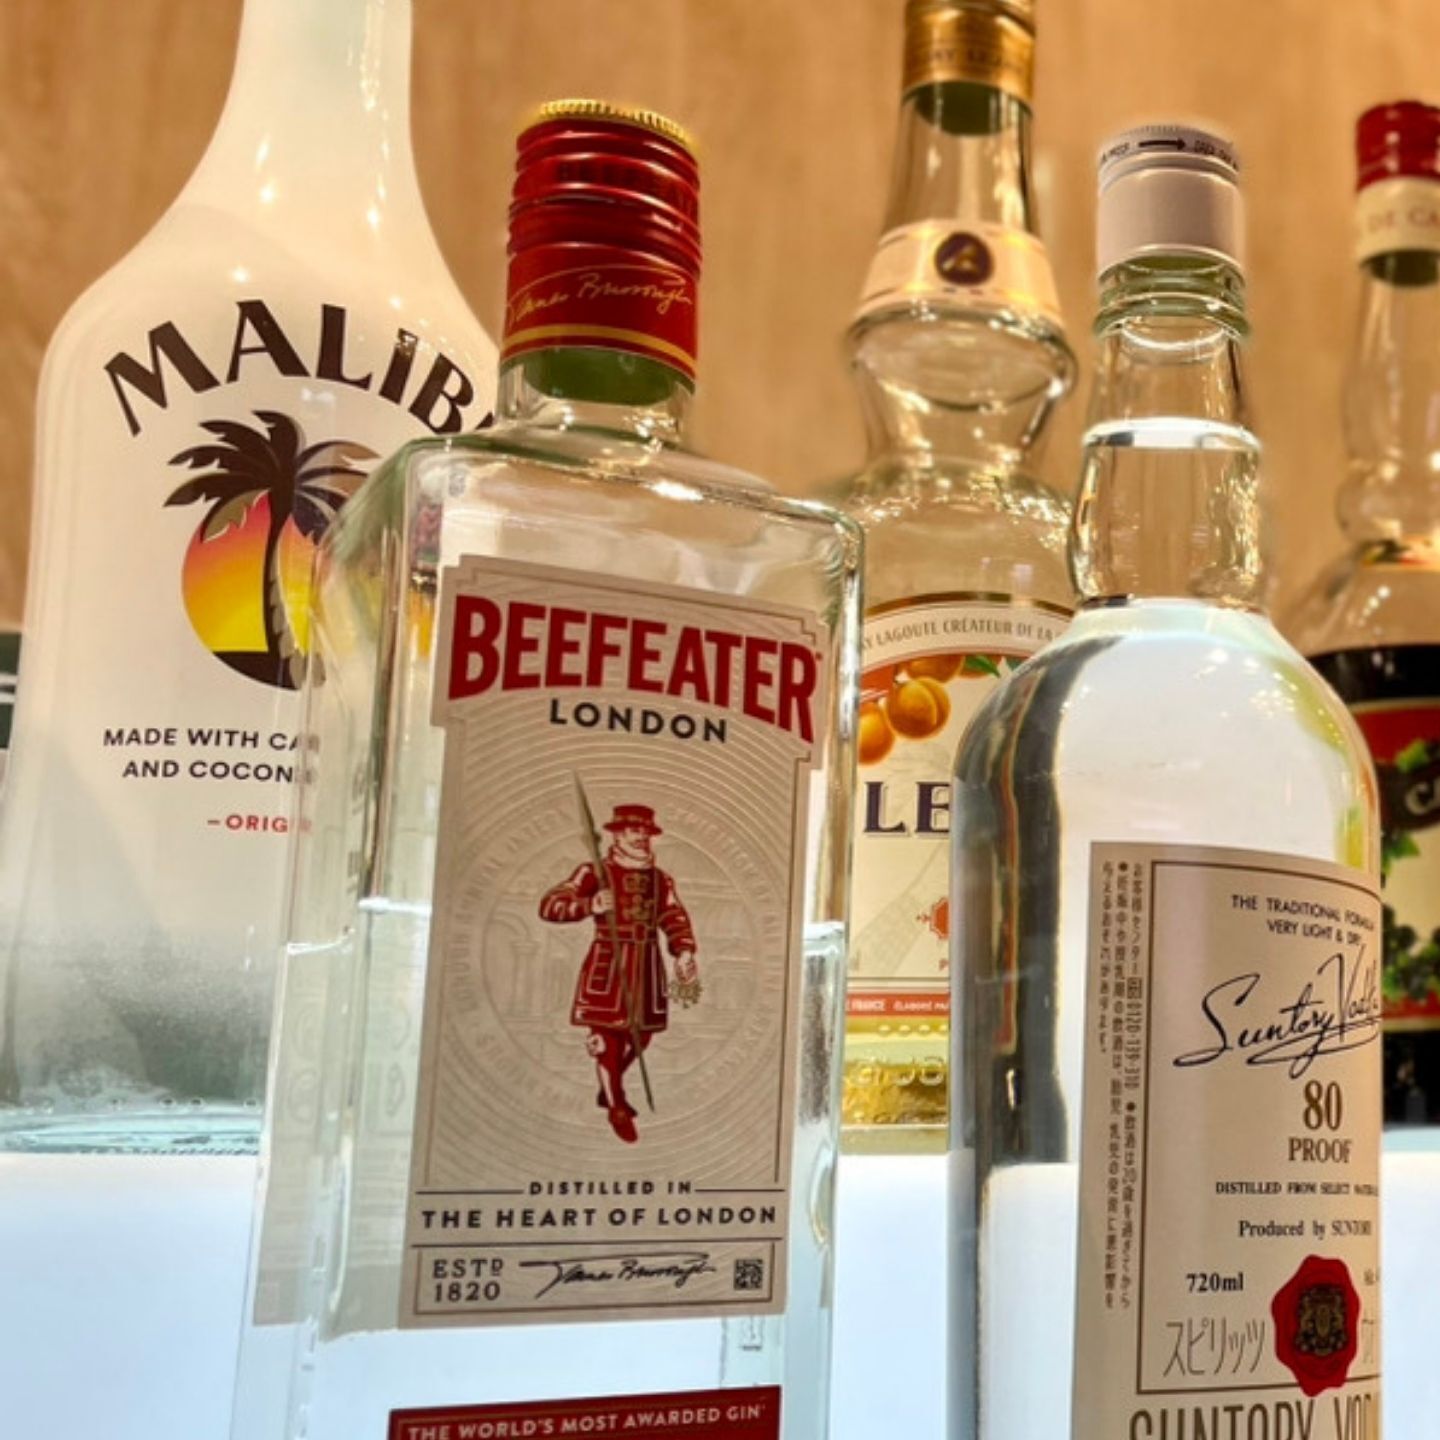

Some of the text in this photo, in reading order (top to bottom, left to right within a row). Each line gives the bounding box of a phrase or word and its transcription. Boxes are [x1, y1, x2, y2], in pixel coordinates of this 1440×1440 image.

[104, 300, 494, 436] MALIB
[449, 595, 814, 743] BEEFEATER
[549, 699, 726, 743] LONDON
[103, 728, 177, 747] MADE
[187, 729, 259, 749] WITH
[122, 760, 180, 779] AND
[1231, 895, 1257, 910] THE
[1267, 919, 1298, 934] VERY
[1303, 1080, 1342, 1131] 80
[1288, 1137, 1351, 1163] PROOF
[530, 1181, 692, 1196] DISTILLED IN
[1215, 1182, 1282, 1195] DISTILLED
[421, 1205, 776, 1229] THE HEART OF LONDON
[1239, 1219, 1304, 1238] Produced
[1313, 1219, 1325, 1240] by
[433, 1281, 501, 1302] 1820
[1187, 1272, 1244, 1293] 720ml
[1163, 1317, 1266, 1377] スピリッツ
[408, 1425, 449, 1440] THE
[458, 1418, 554, 1439] WORLD'S
[561, 1413, 617, 1434] MOST
[623, 1406, 720, 1429] AWARDED
